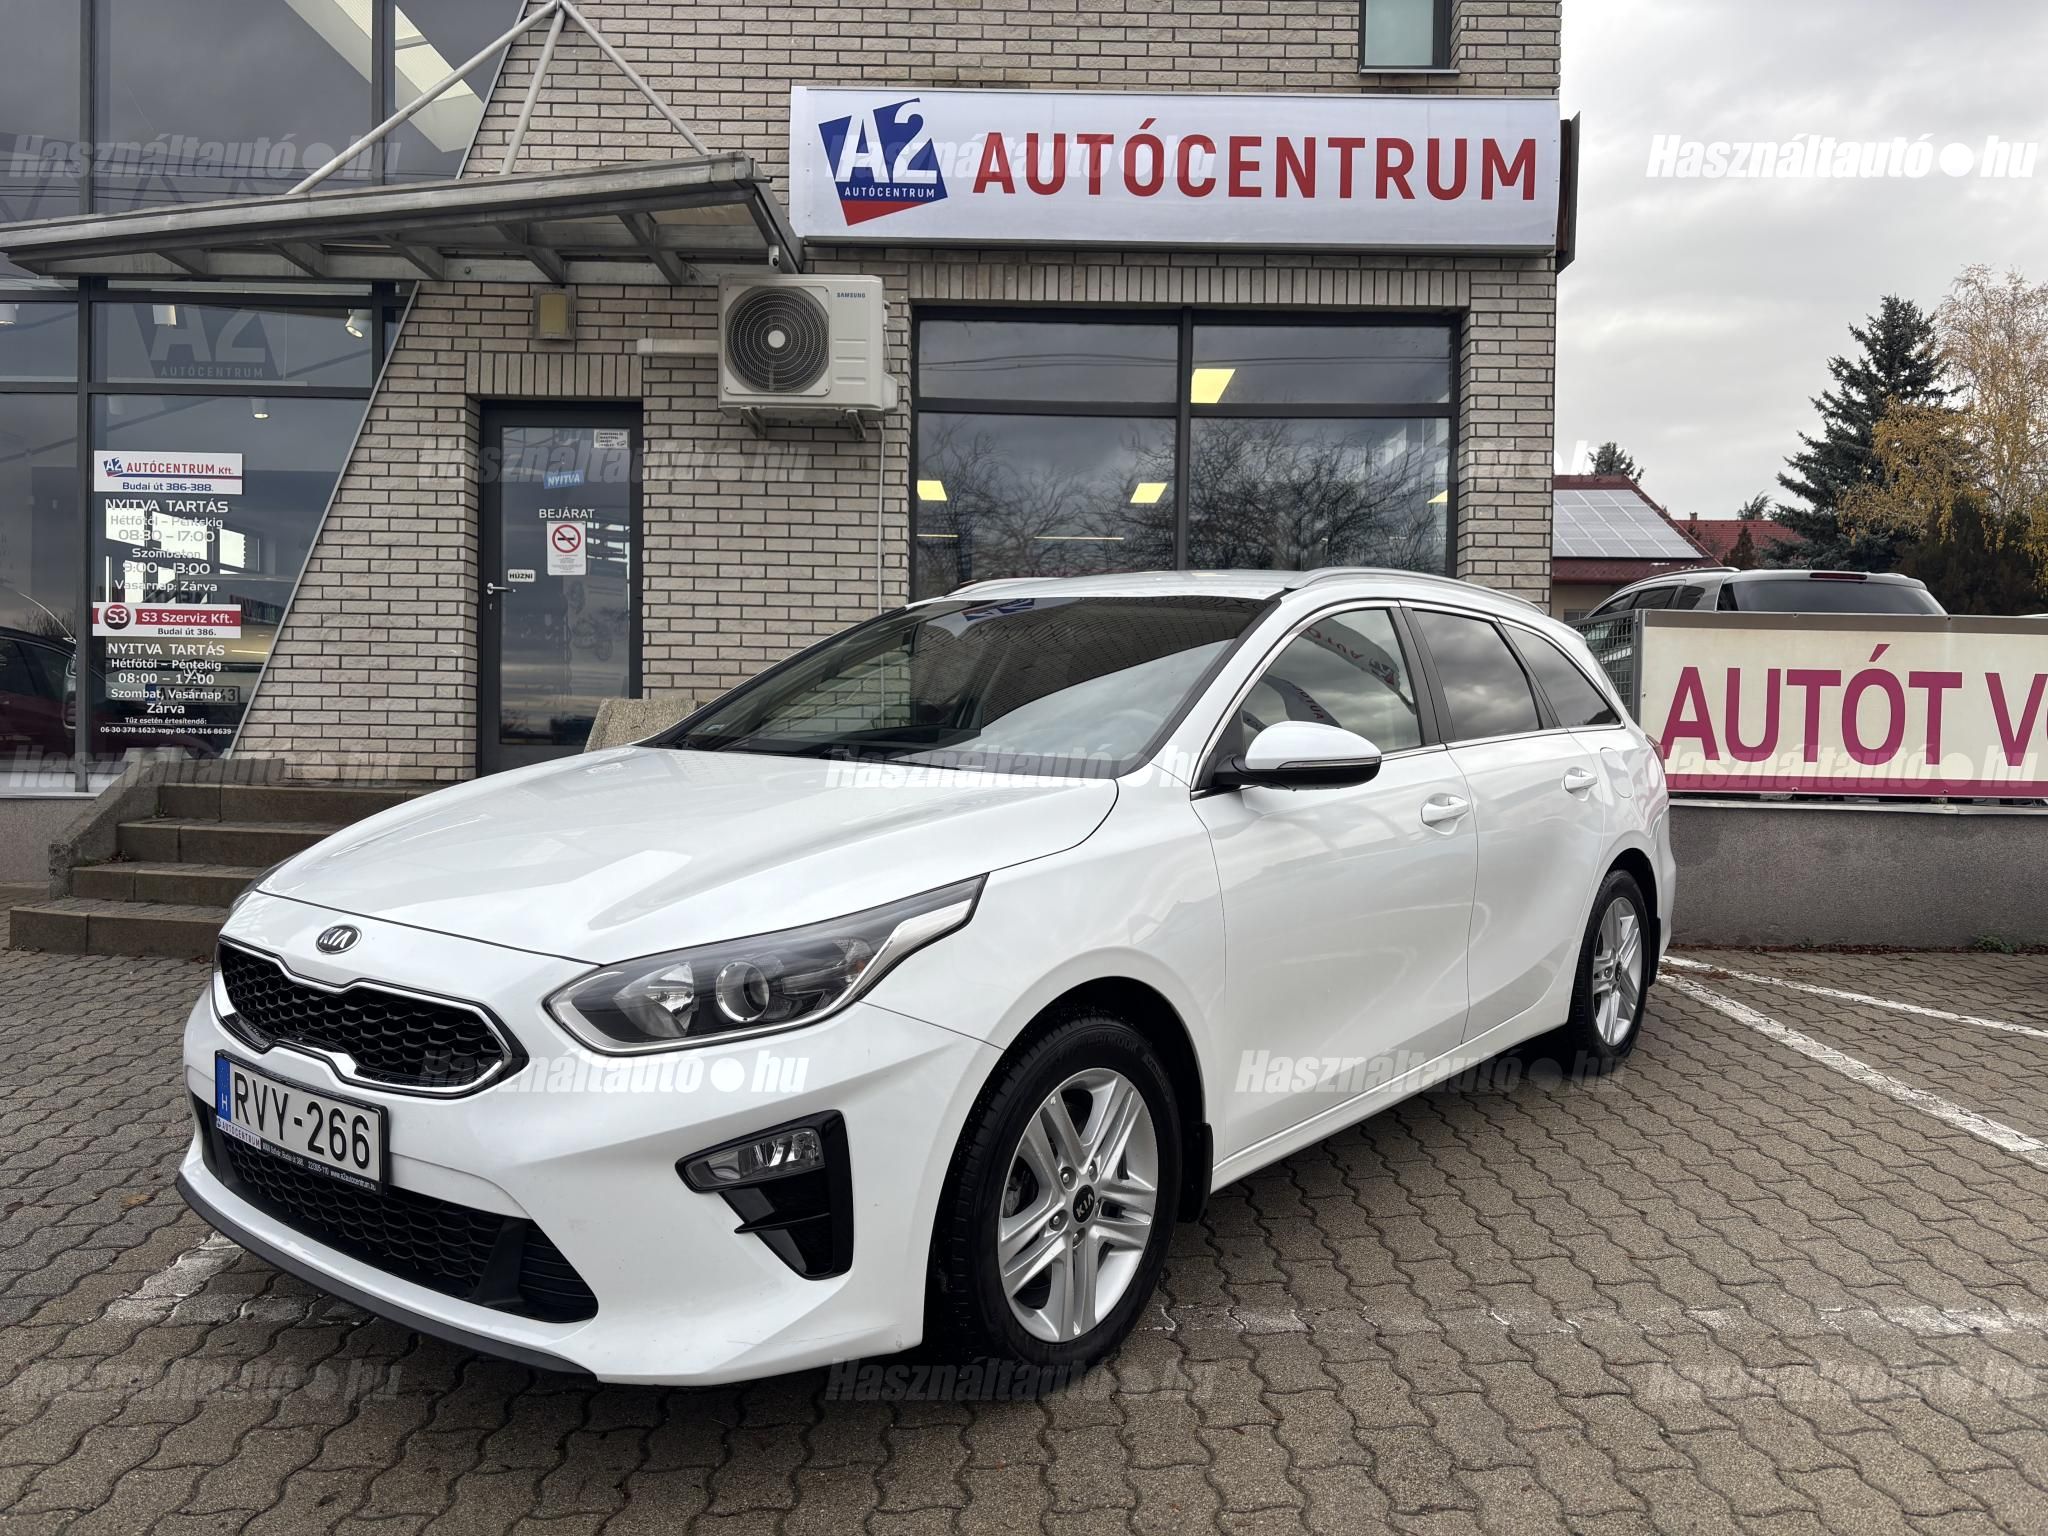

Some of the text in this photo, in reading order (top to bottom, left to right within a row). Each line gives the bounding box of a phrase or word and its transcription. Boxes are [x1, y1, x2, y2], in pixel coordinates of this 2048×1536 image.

[834, 101, 938, 184] A2
[973, 118, 1536, 202] AUTÓCENTRUM
[844, 185, 936, 199] AUTÓCENTRUM
[161, 363, 263, 378] AUTÓCENTRUM
[105, 457, 234, 475] A2 AUTÓCENTRUM Kft.
[548, 473, 580, 486] NYITVA
[122, 482, 214, 492] Budai út 386-388.
[106, 498, 229, 513] NYITVA TARTÁS
[539, 507, 595, 519] BEJÁRAT
[111, 515, 158, 527] Hétfőtől
[172, 516, 223, 529] Péntekig
[178, 531, 215, 542] 17:00
[132, 548, 201, 560] Szombaton
[122, 562, 158, 574] 9:00
[174, 563, 210, 575] 13:00
[115, 579, 218, 592] Vasárnap: Zárva
[107, 608, 127, 624] S3
[142, 613, 233, 624] S3 Szerviz Kft.
[157, 627, 217, 636] Budai út 386.
[108, 641, 225, 655] NYITVA TARTÁS
[112, 659, 157, 669] Hétfőtől
[172, 660, 222, 671] Péntekig
[118, 673, 158, 684] 08:00
[176, 674, 215, 685] 17:00
[111, 688, 165, 699] Szombat,
[169, 688, 222, 700] Vasárnap
[147, 702, 185, 714] Zárva
[1658, 643, 2048, 768] AUTÓT V
[318, 927, 353, 949] KIA
[220, 1094, 228, 1112] H
[234, 1072, 370, 1170] RVY-266
[1076, 1193, 1095, 1217] KIA
